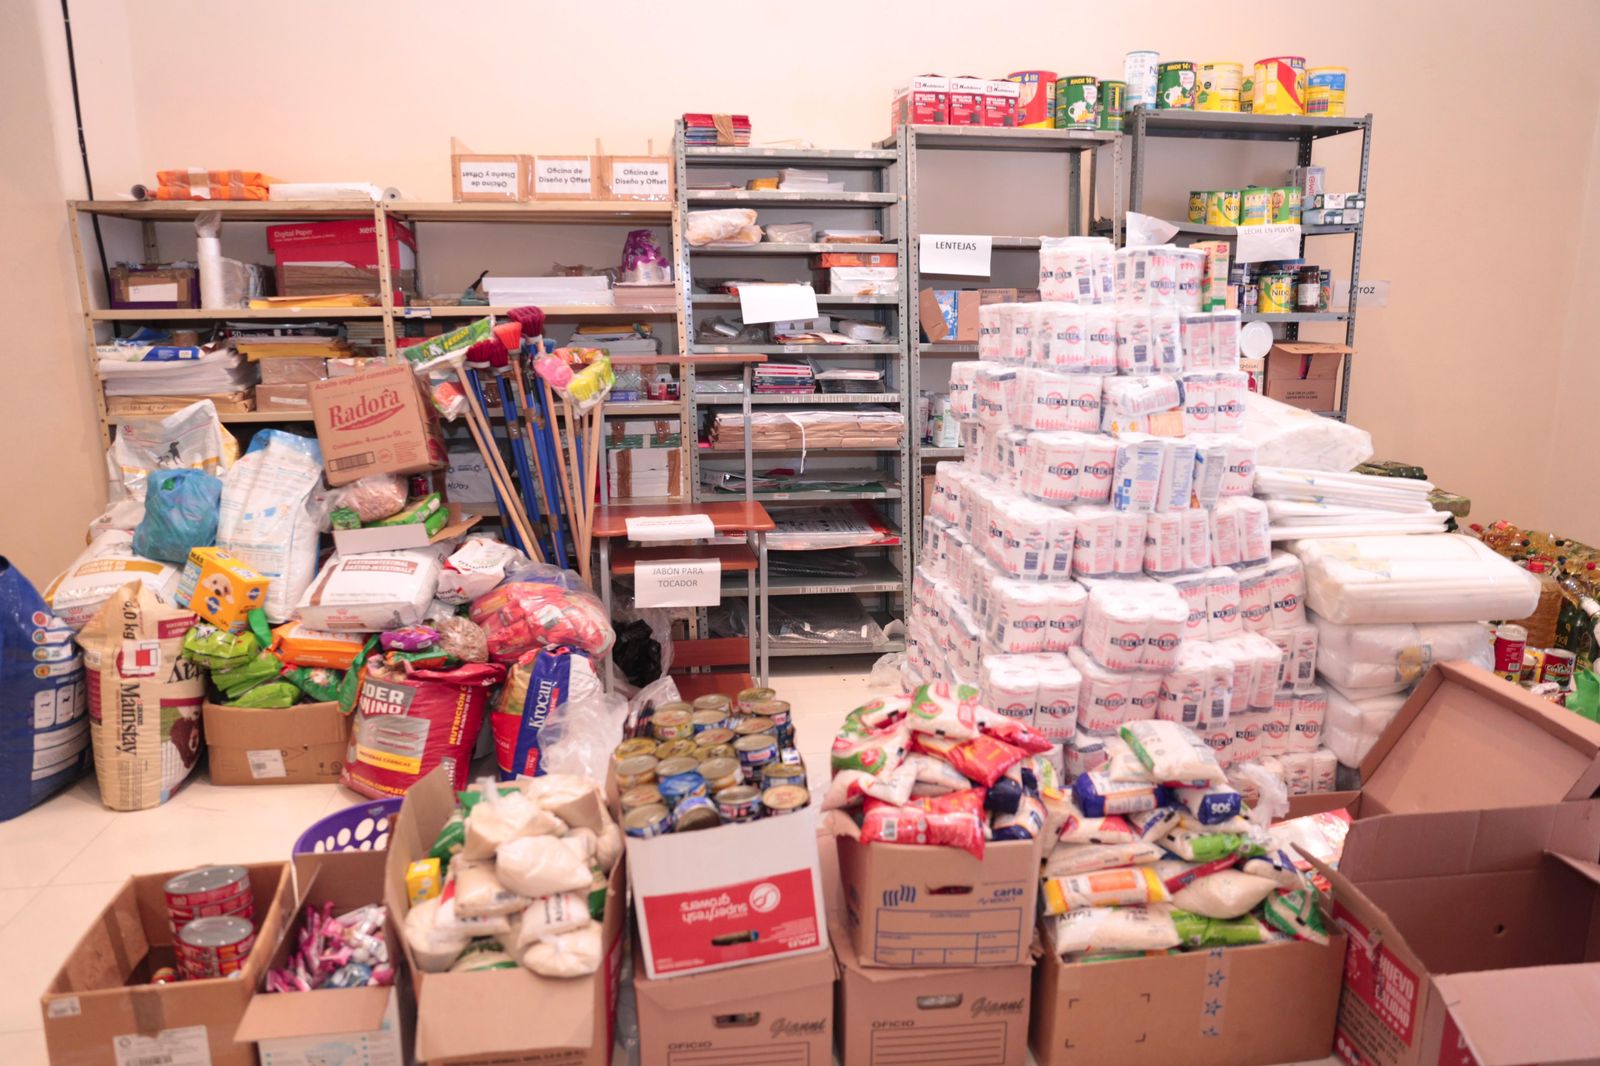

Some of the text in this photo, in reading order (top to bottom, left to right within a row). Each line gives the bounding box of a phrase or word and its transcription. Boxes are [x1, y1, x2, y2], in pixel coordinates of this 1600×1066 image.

[546, 167, 573, 175] Oficina
[538, 175, 563, 183] Diseño
[569, 175, 591, 183] Offset
[274, 229, 296, 239] Digital
[296, 228, 313, 237] Paper
[935, 241, 977, 251] LENTEJAS
[682, 567, 704, 575] PARA
[658, 580, 698, 588] TOCADOR
[528, 680, 554, 730] Krocan
[116, 683, 141, 756] Mainstay
[1211, 802, 1232, 814] SOS
[993, 887, 1024, 897] carta
[680, 892, 731, 911] growers
[681, 902, 749, 924] superfresh
[871, 1020, 915, 1029] OFICIO
[667, 1041, 713, 1050] OFICIO
